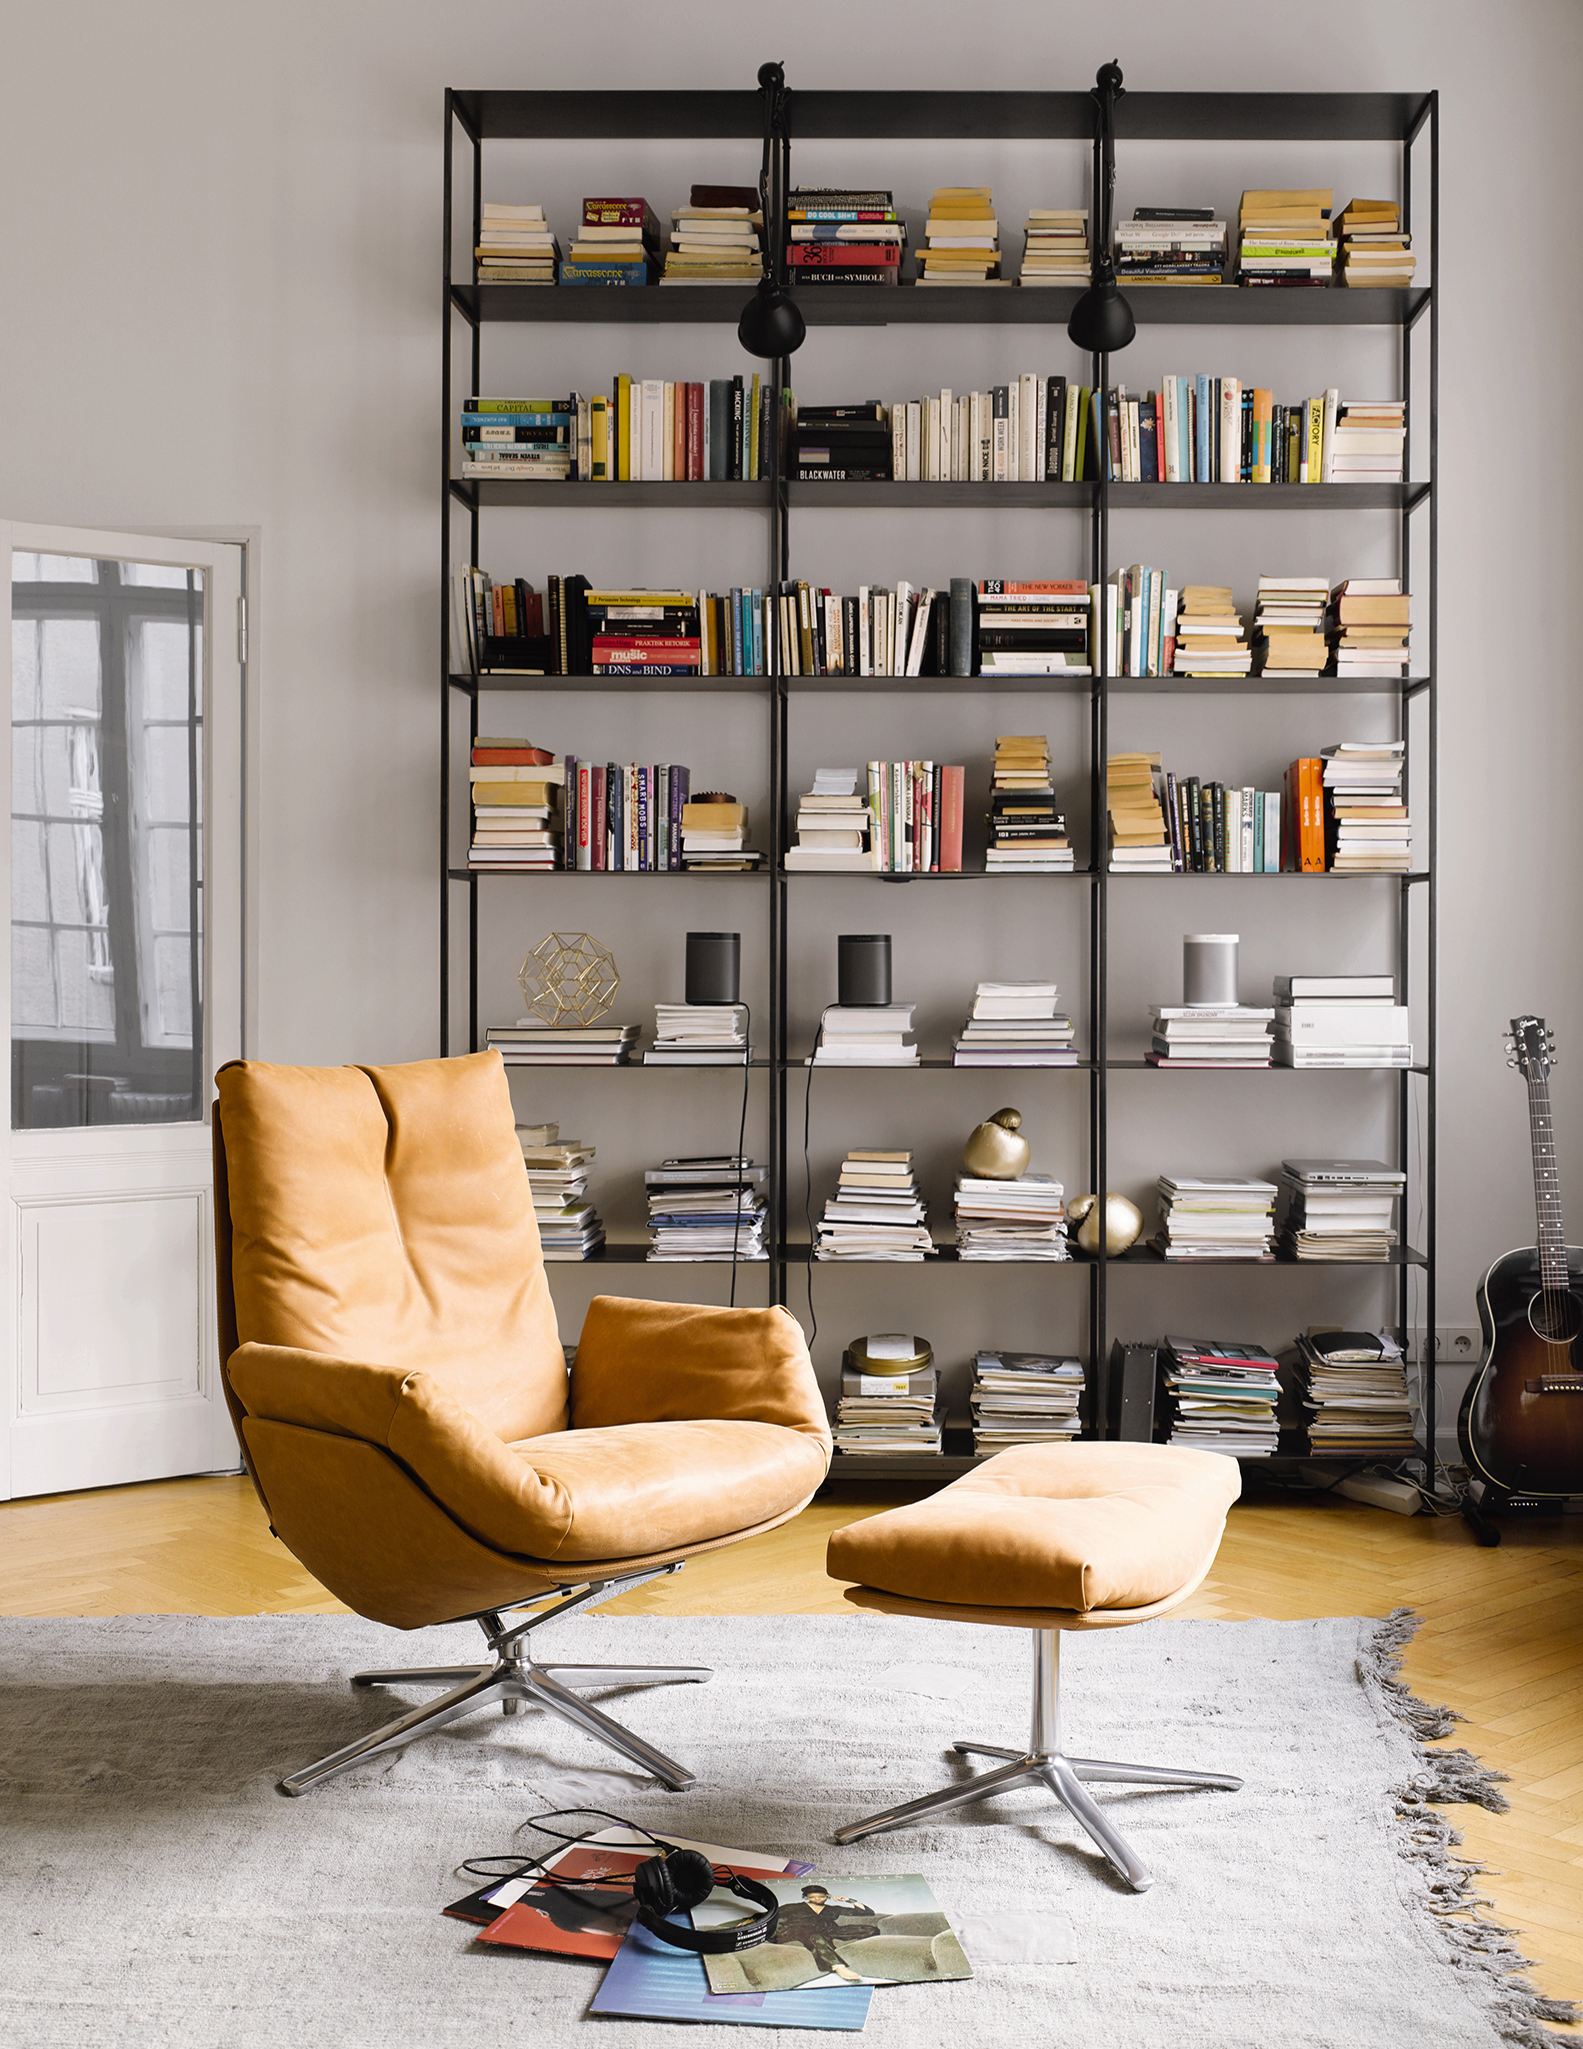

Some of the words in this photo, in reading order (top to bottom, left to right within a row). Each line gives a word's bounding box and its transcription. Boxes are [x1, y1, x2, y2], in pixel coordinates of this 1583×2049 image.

[803, 246, 822, 264] 36
[564, 266, 623, 278] Carcassonne
[1312, 406, 1321, 445] FACTORY
[1048, 448, 1058, 474] Daemon
[800, 470, 845, 480] BLACKWATER
[611, 650, 647, 660] music
[608, 666, 631, 674] DNS
[643, 666, 671, 674] BIND
